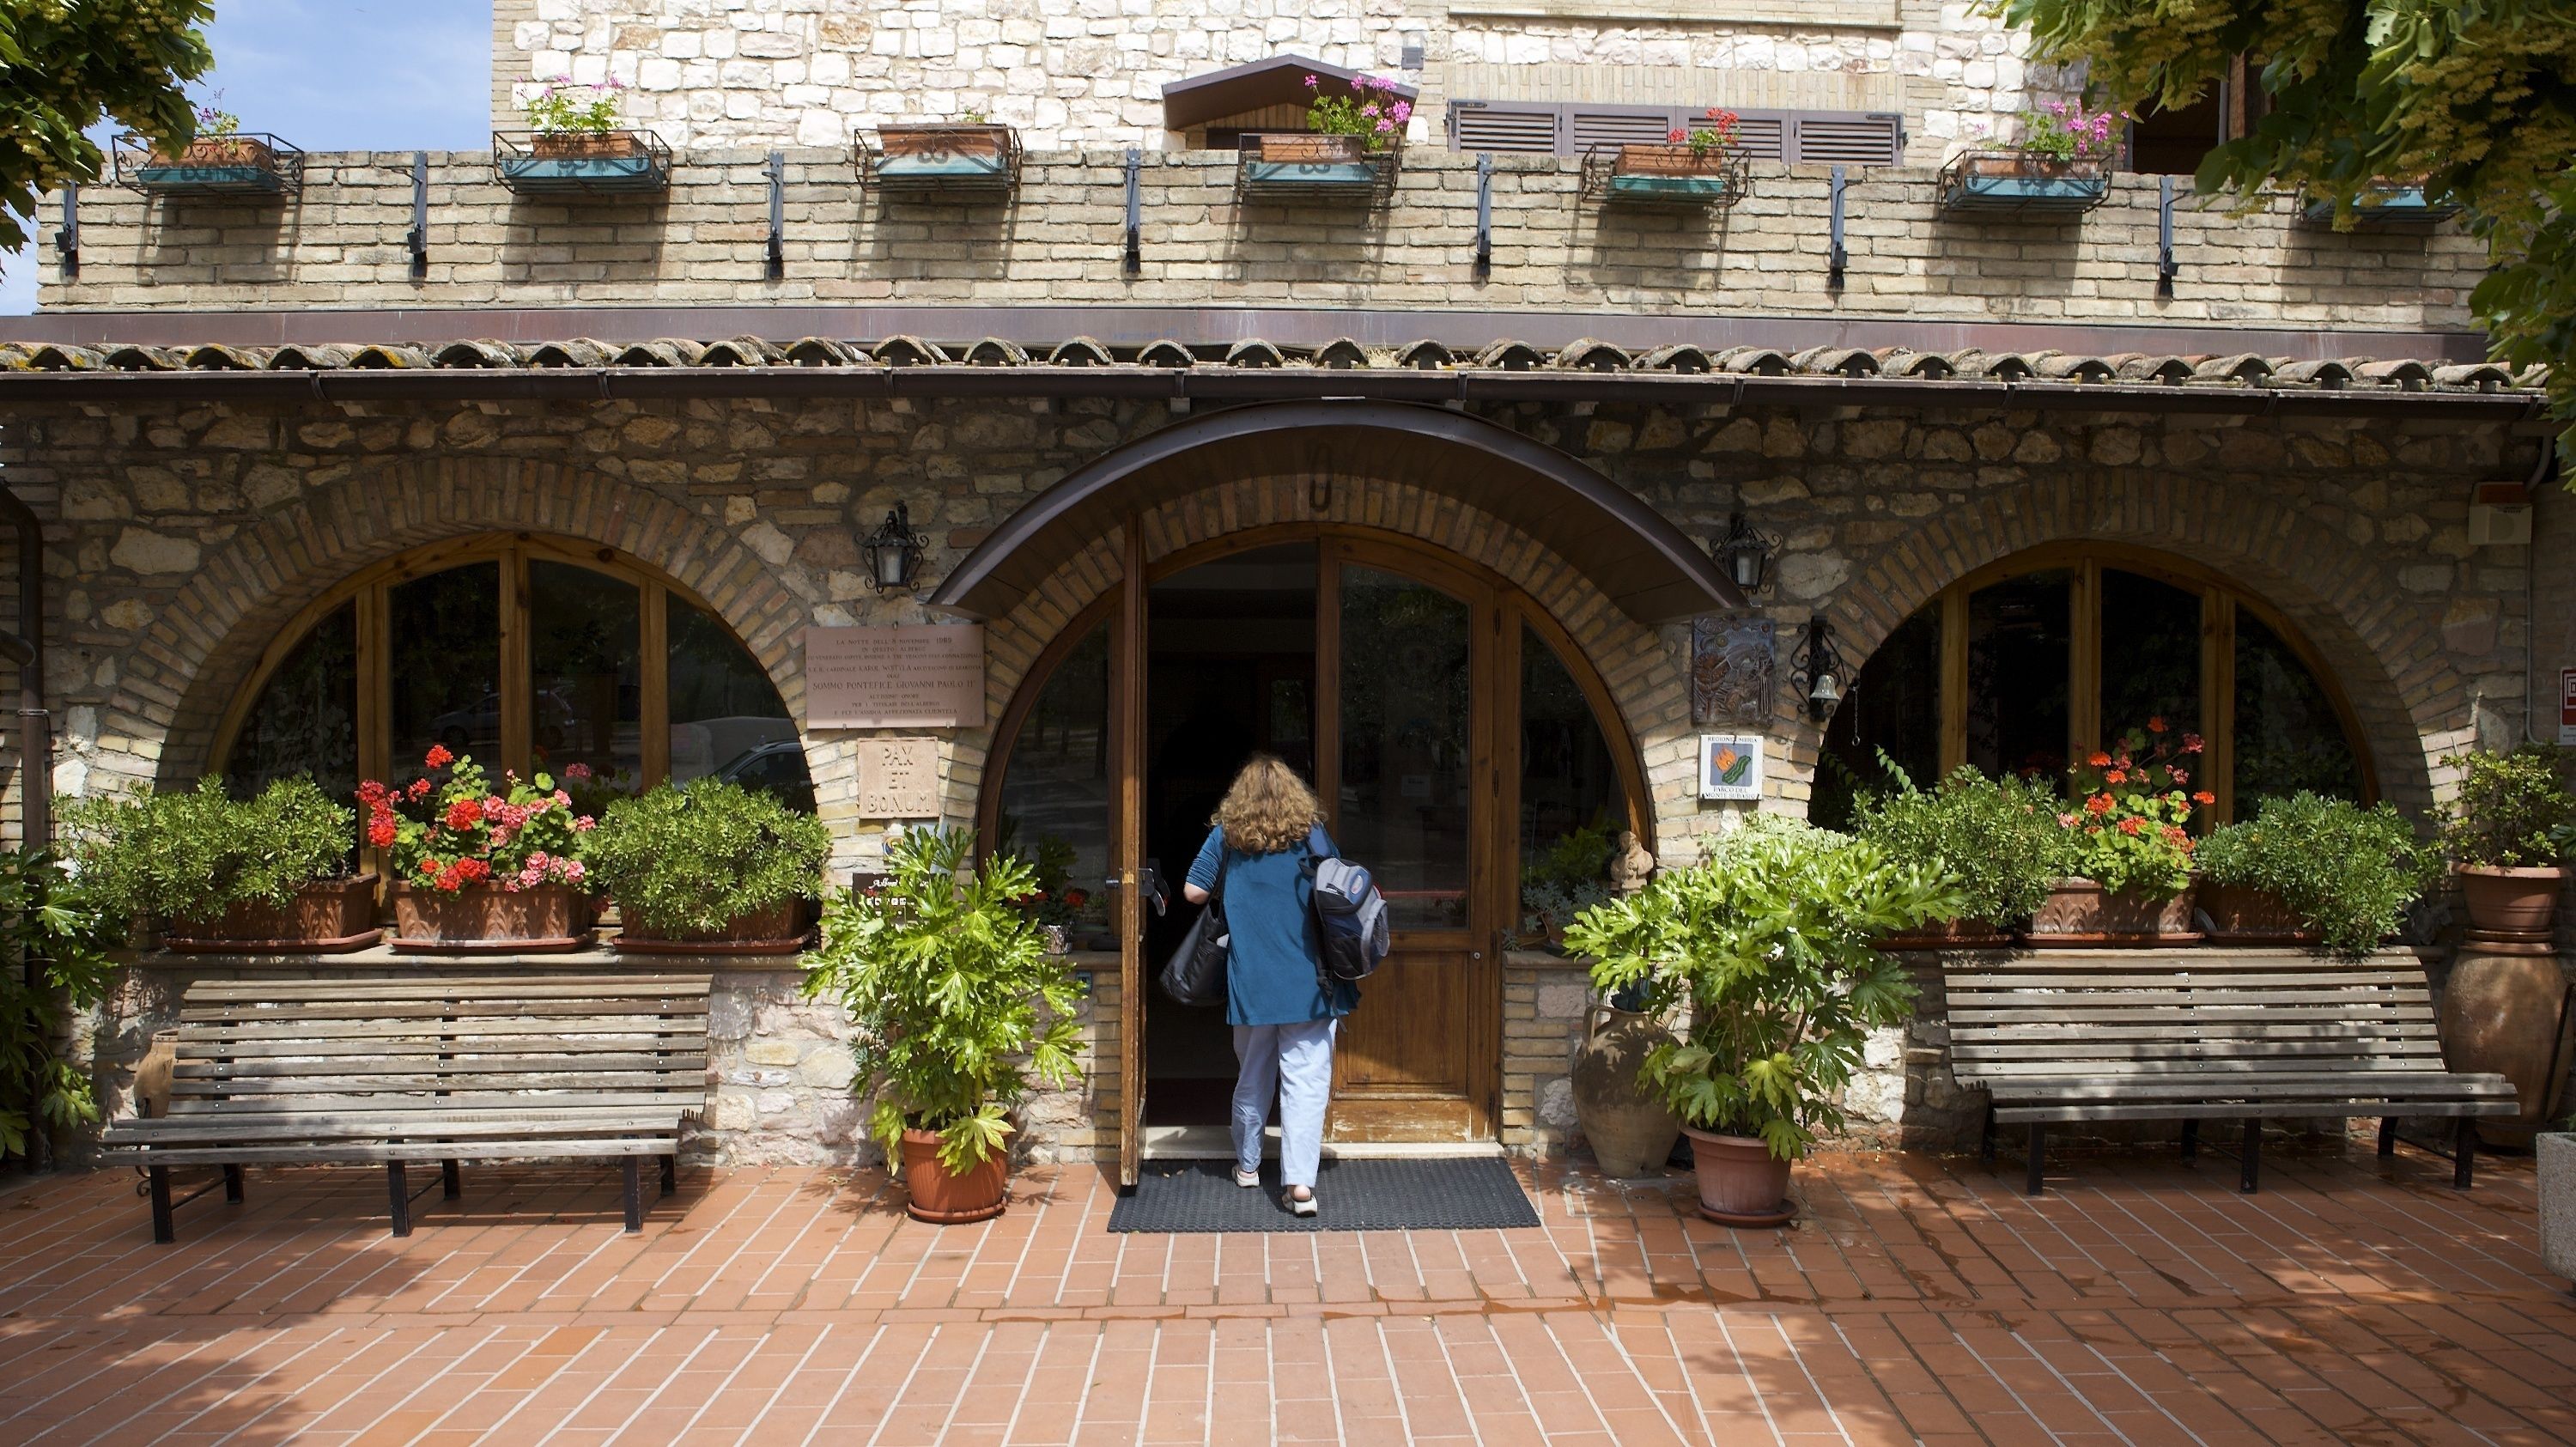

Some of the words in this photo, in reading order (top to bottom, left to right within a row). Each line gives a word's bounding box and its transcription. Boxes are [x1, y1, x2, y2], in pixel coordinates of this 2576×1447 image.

[812, 681, 843, 690] SOMMO
[847, 681, 893, 690] PONTEFICE
[896, 680, 934, 689] GIOVANNI
[938, 679, 963, 688] PAOLO
[881, 745, 914, 767] PAX
[888, 769, 910, 789] ET
[867, 791, 932, 813] BONUM
